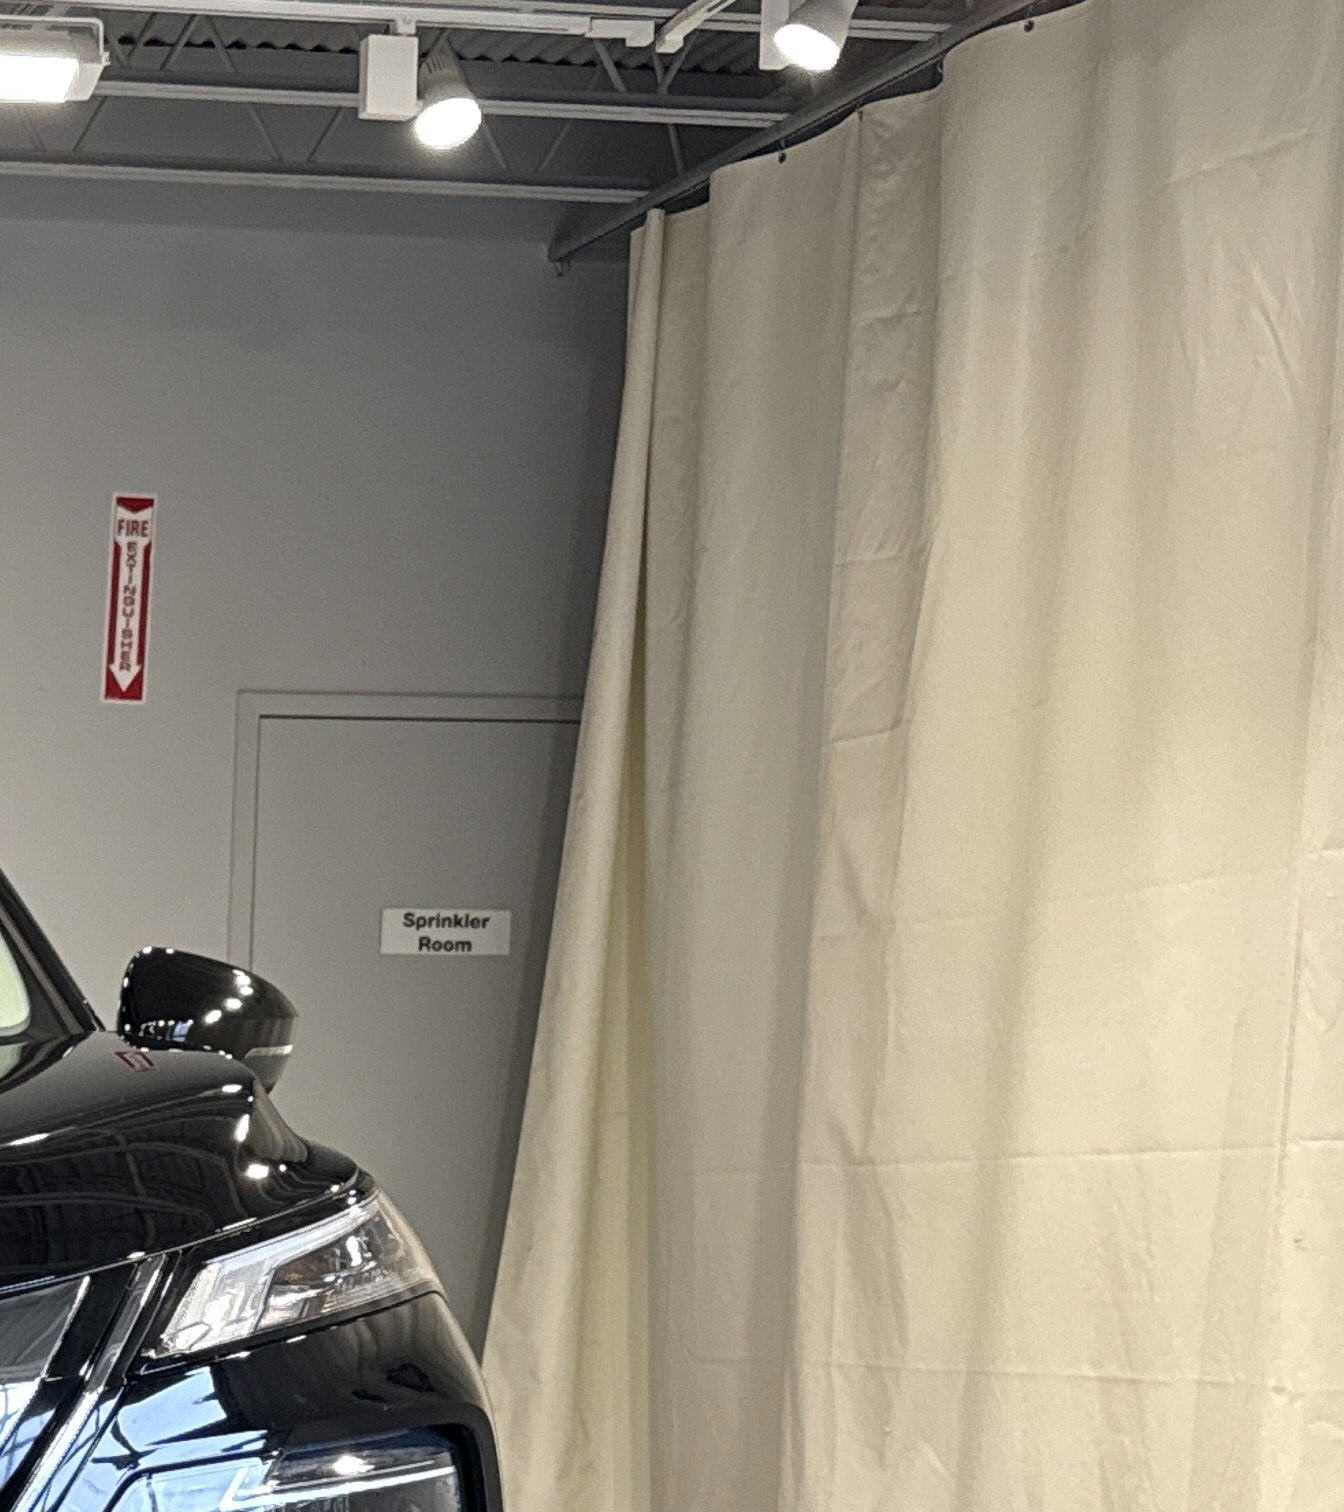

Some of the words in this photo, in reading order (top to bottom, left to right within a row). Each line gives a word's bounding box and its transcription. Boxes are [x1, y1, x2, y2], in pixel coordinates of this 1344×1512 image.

[117, 519, 149, 537] FIRE
[119, 541, 138, 671] EXTINGUISHER
[403, 912, 490, 930] Sprinkler
[418, 936, 472, 952] Room
